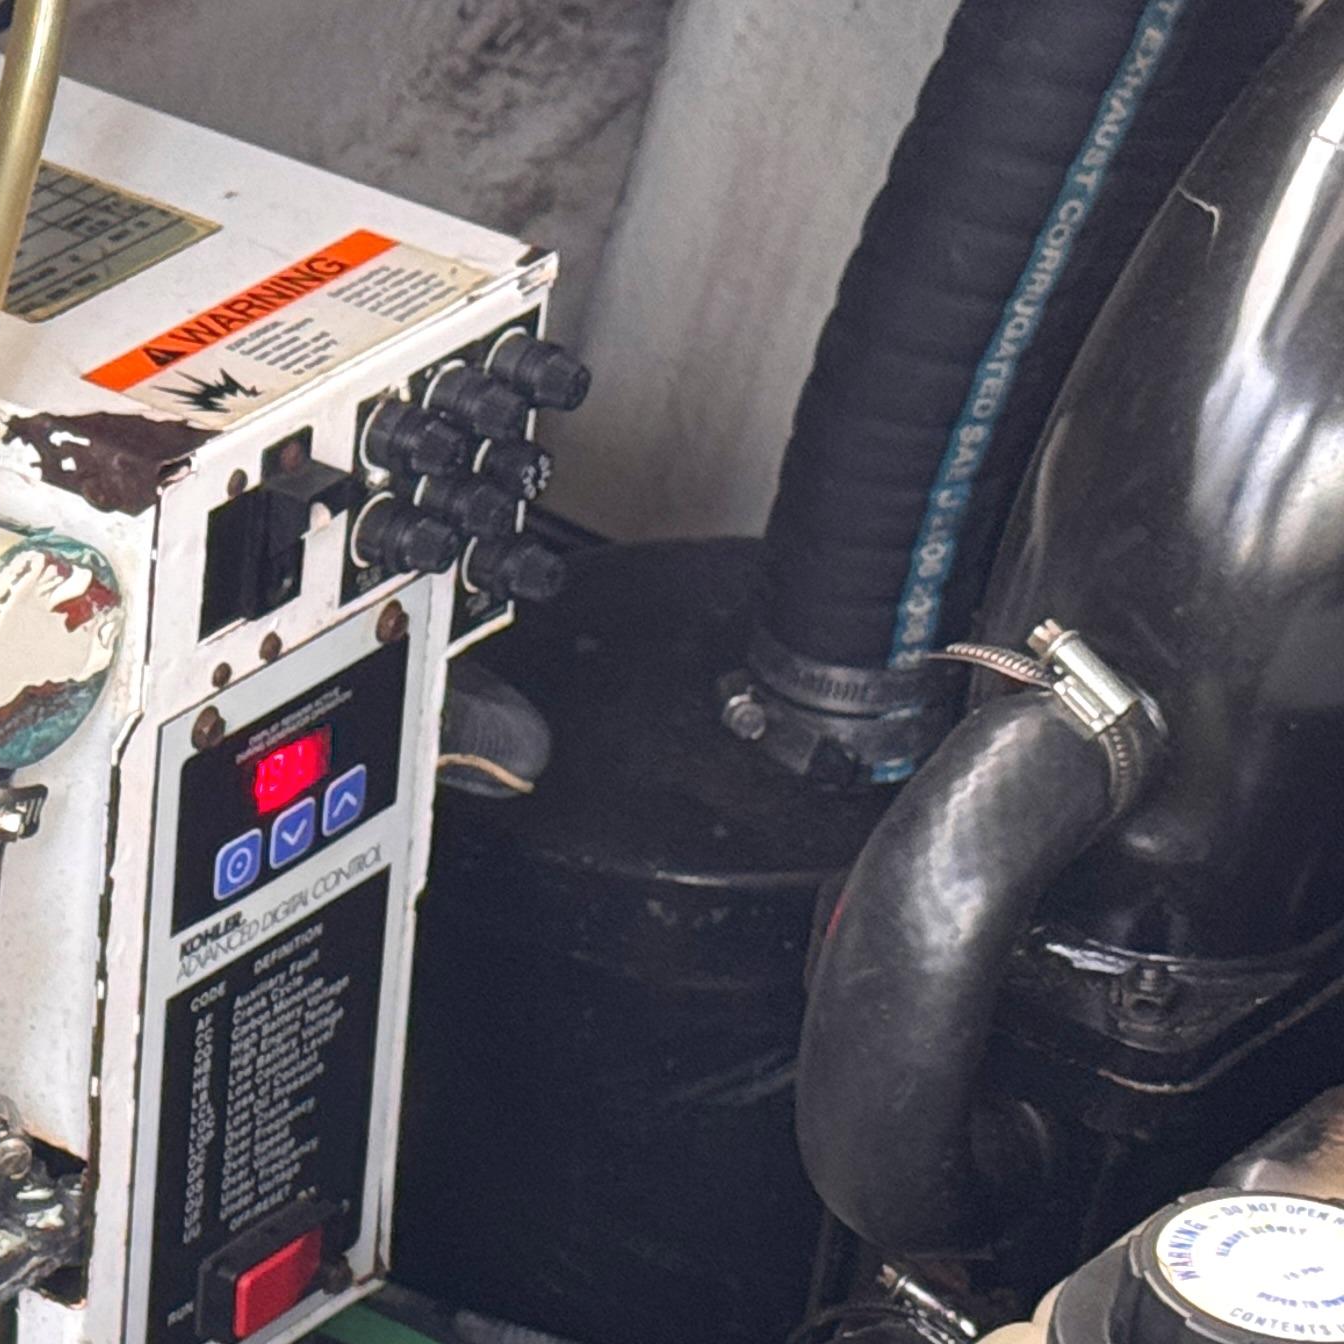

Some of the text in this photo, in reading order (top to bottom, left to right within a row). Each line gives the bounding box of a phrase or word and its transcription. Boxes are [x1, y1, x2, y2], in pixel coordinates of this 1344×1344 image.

[169, 256, 349, 346] WARNING
[958, 197, 1087, 426] CORRUGATED
[176, 842, 383, 984] ADVANCED DIGITAL CONTROL
[1167, 1218, 1209, 1282] WARNING
[1246, 1202, 1278, 1214] NOT
[1285, 1203, 1330, 1222] OPEN
[167, 1301, 194, 1328] RUN
[1228, 1306, 1333, 1337] CONTENTS
